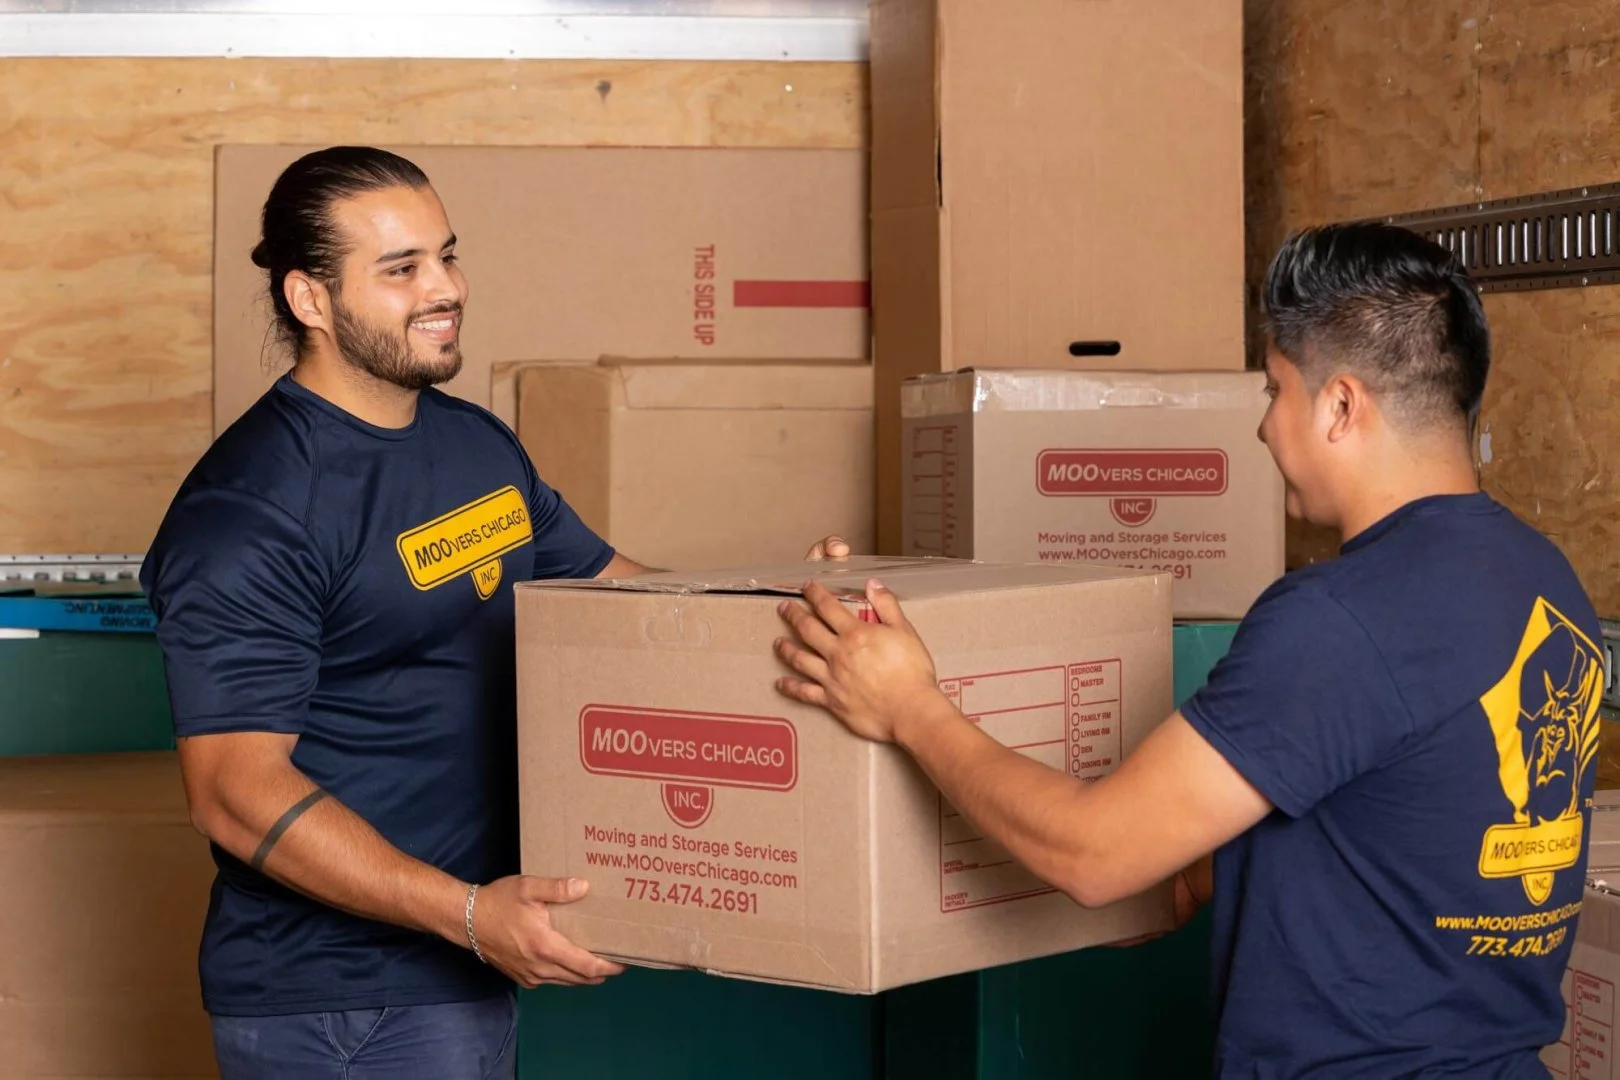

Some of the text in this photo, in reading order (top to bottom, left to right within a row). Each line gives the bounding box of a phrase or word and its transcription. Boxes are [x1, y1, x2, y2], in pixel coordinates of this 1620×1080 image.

[694, 244, 714, 345] THIS SIDE UP
[1047, 464, 1217, 482] MOOVERS CHICAGO
[414, 508, 525, 570] MOOVERS CHICAGO
[1038, 532, 1226, 545] Moving and Storage Services
[1039, 548, 1226, 561] www.MOOversChicago.com
[1080, 678, 1104, 688] MASTER
[592, 728, 785, 767] MOOVERS CHICAGO
[674, 790, 705, 810] INC.
[584, 825, 798, 863] Moving and Storage Services
[586, 852, 798, 888] www.MOOversChicago.com
[624, 878, 758, 914] 773.474.2691
